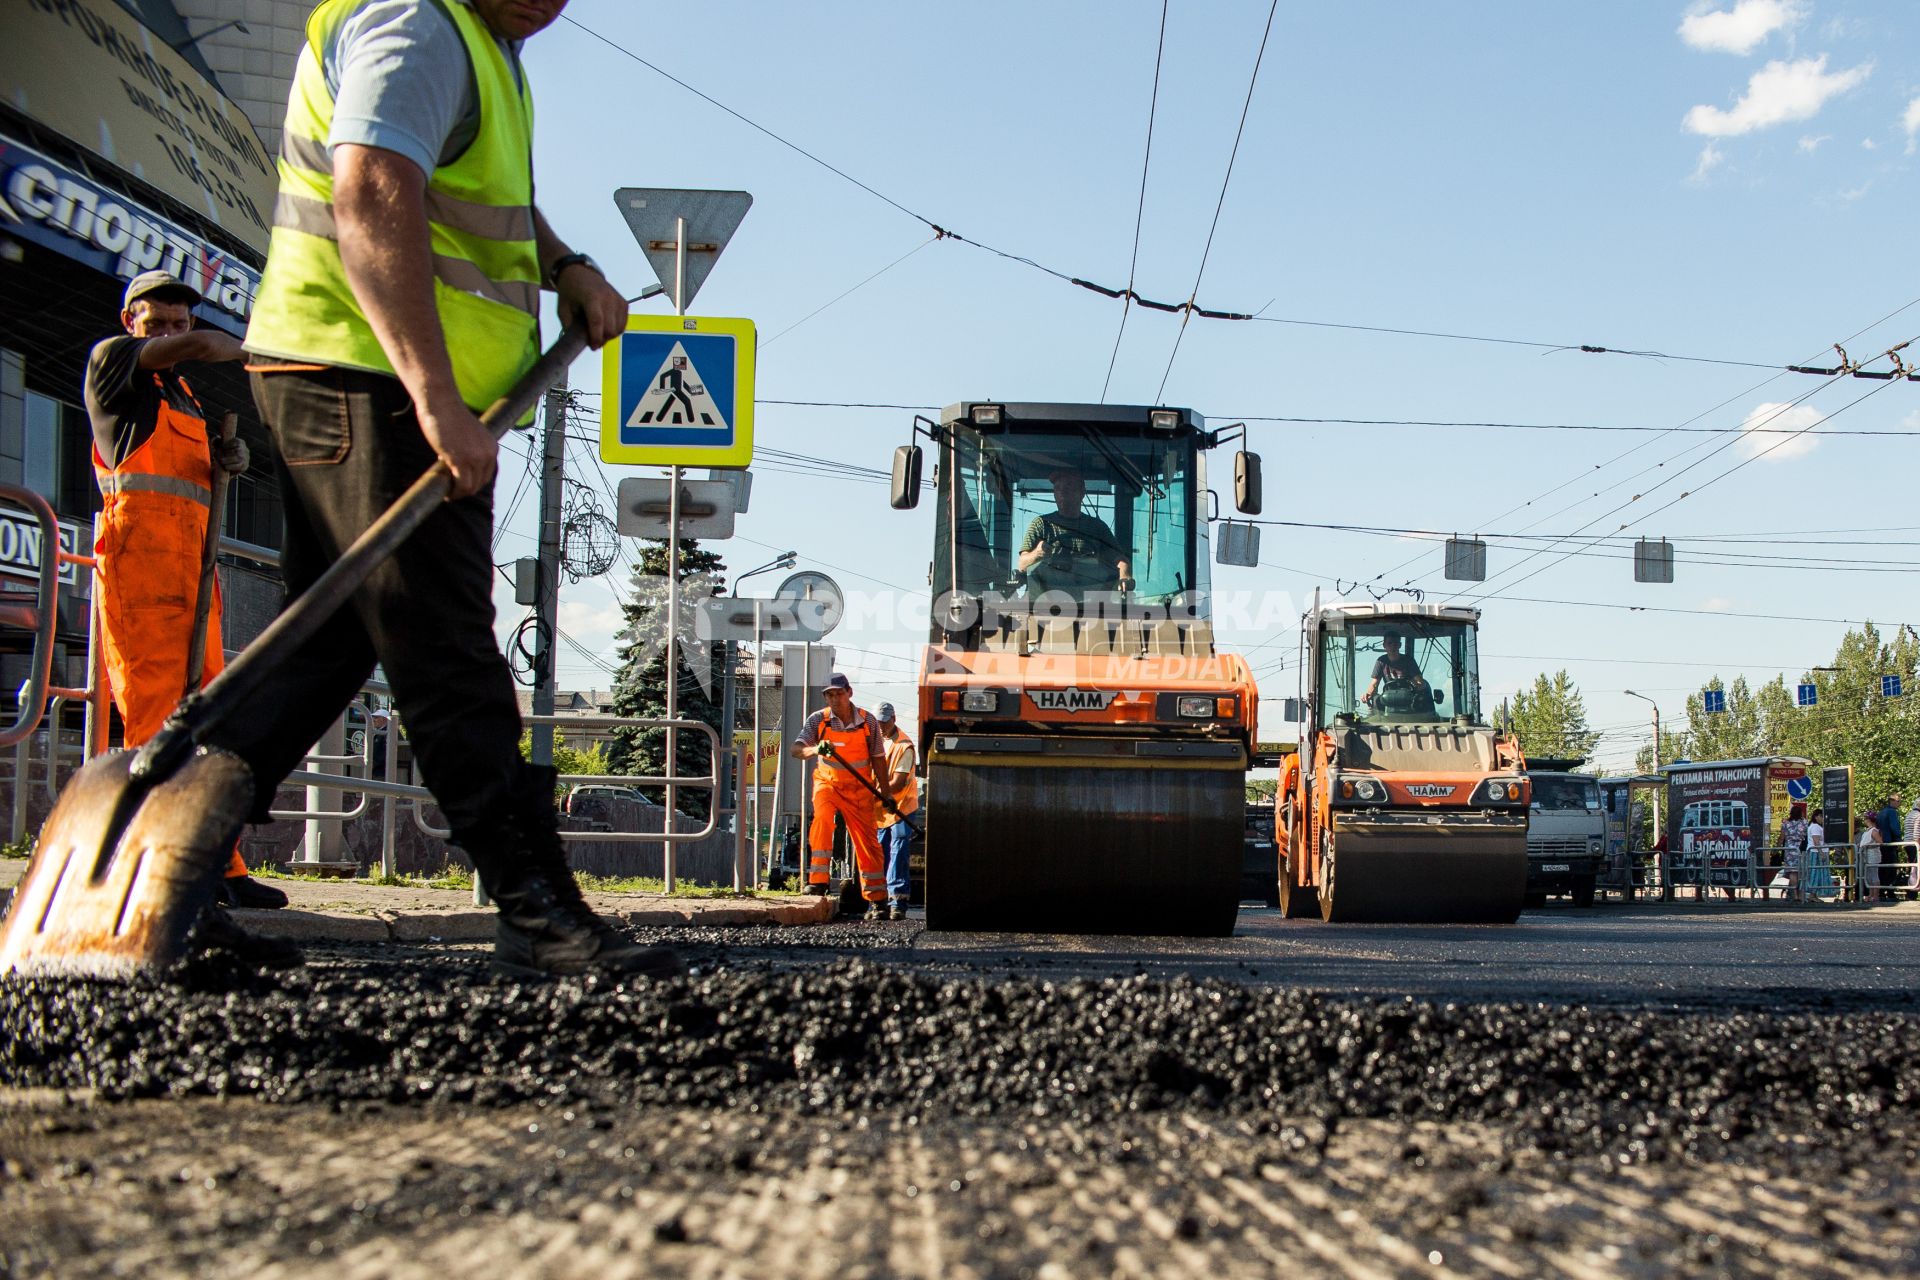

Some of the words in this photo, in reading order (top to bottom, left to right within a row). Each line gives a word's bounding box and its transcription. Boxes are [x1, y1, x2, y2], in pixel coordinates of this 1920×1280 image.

[179, 80, 268, 177] РАДИО
[155, 133, 234, 208] 106.3
[225, 179, 271, 235] FM
[1040, 691, 1103, 708] HAMM
[1671, 770, 1702, 785] РЕКЛАМА
[1703, 770, 1714, 782] НА
[1714, 768, 1760, 781] ТРАНСПОРТЕ
[1412, 786, 1448, 797] HAMM
